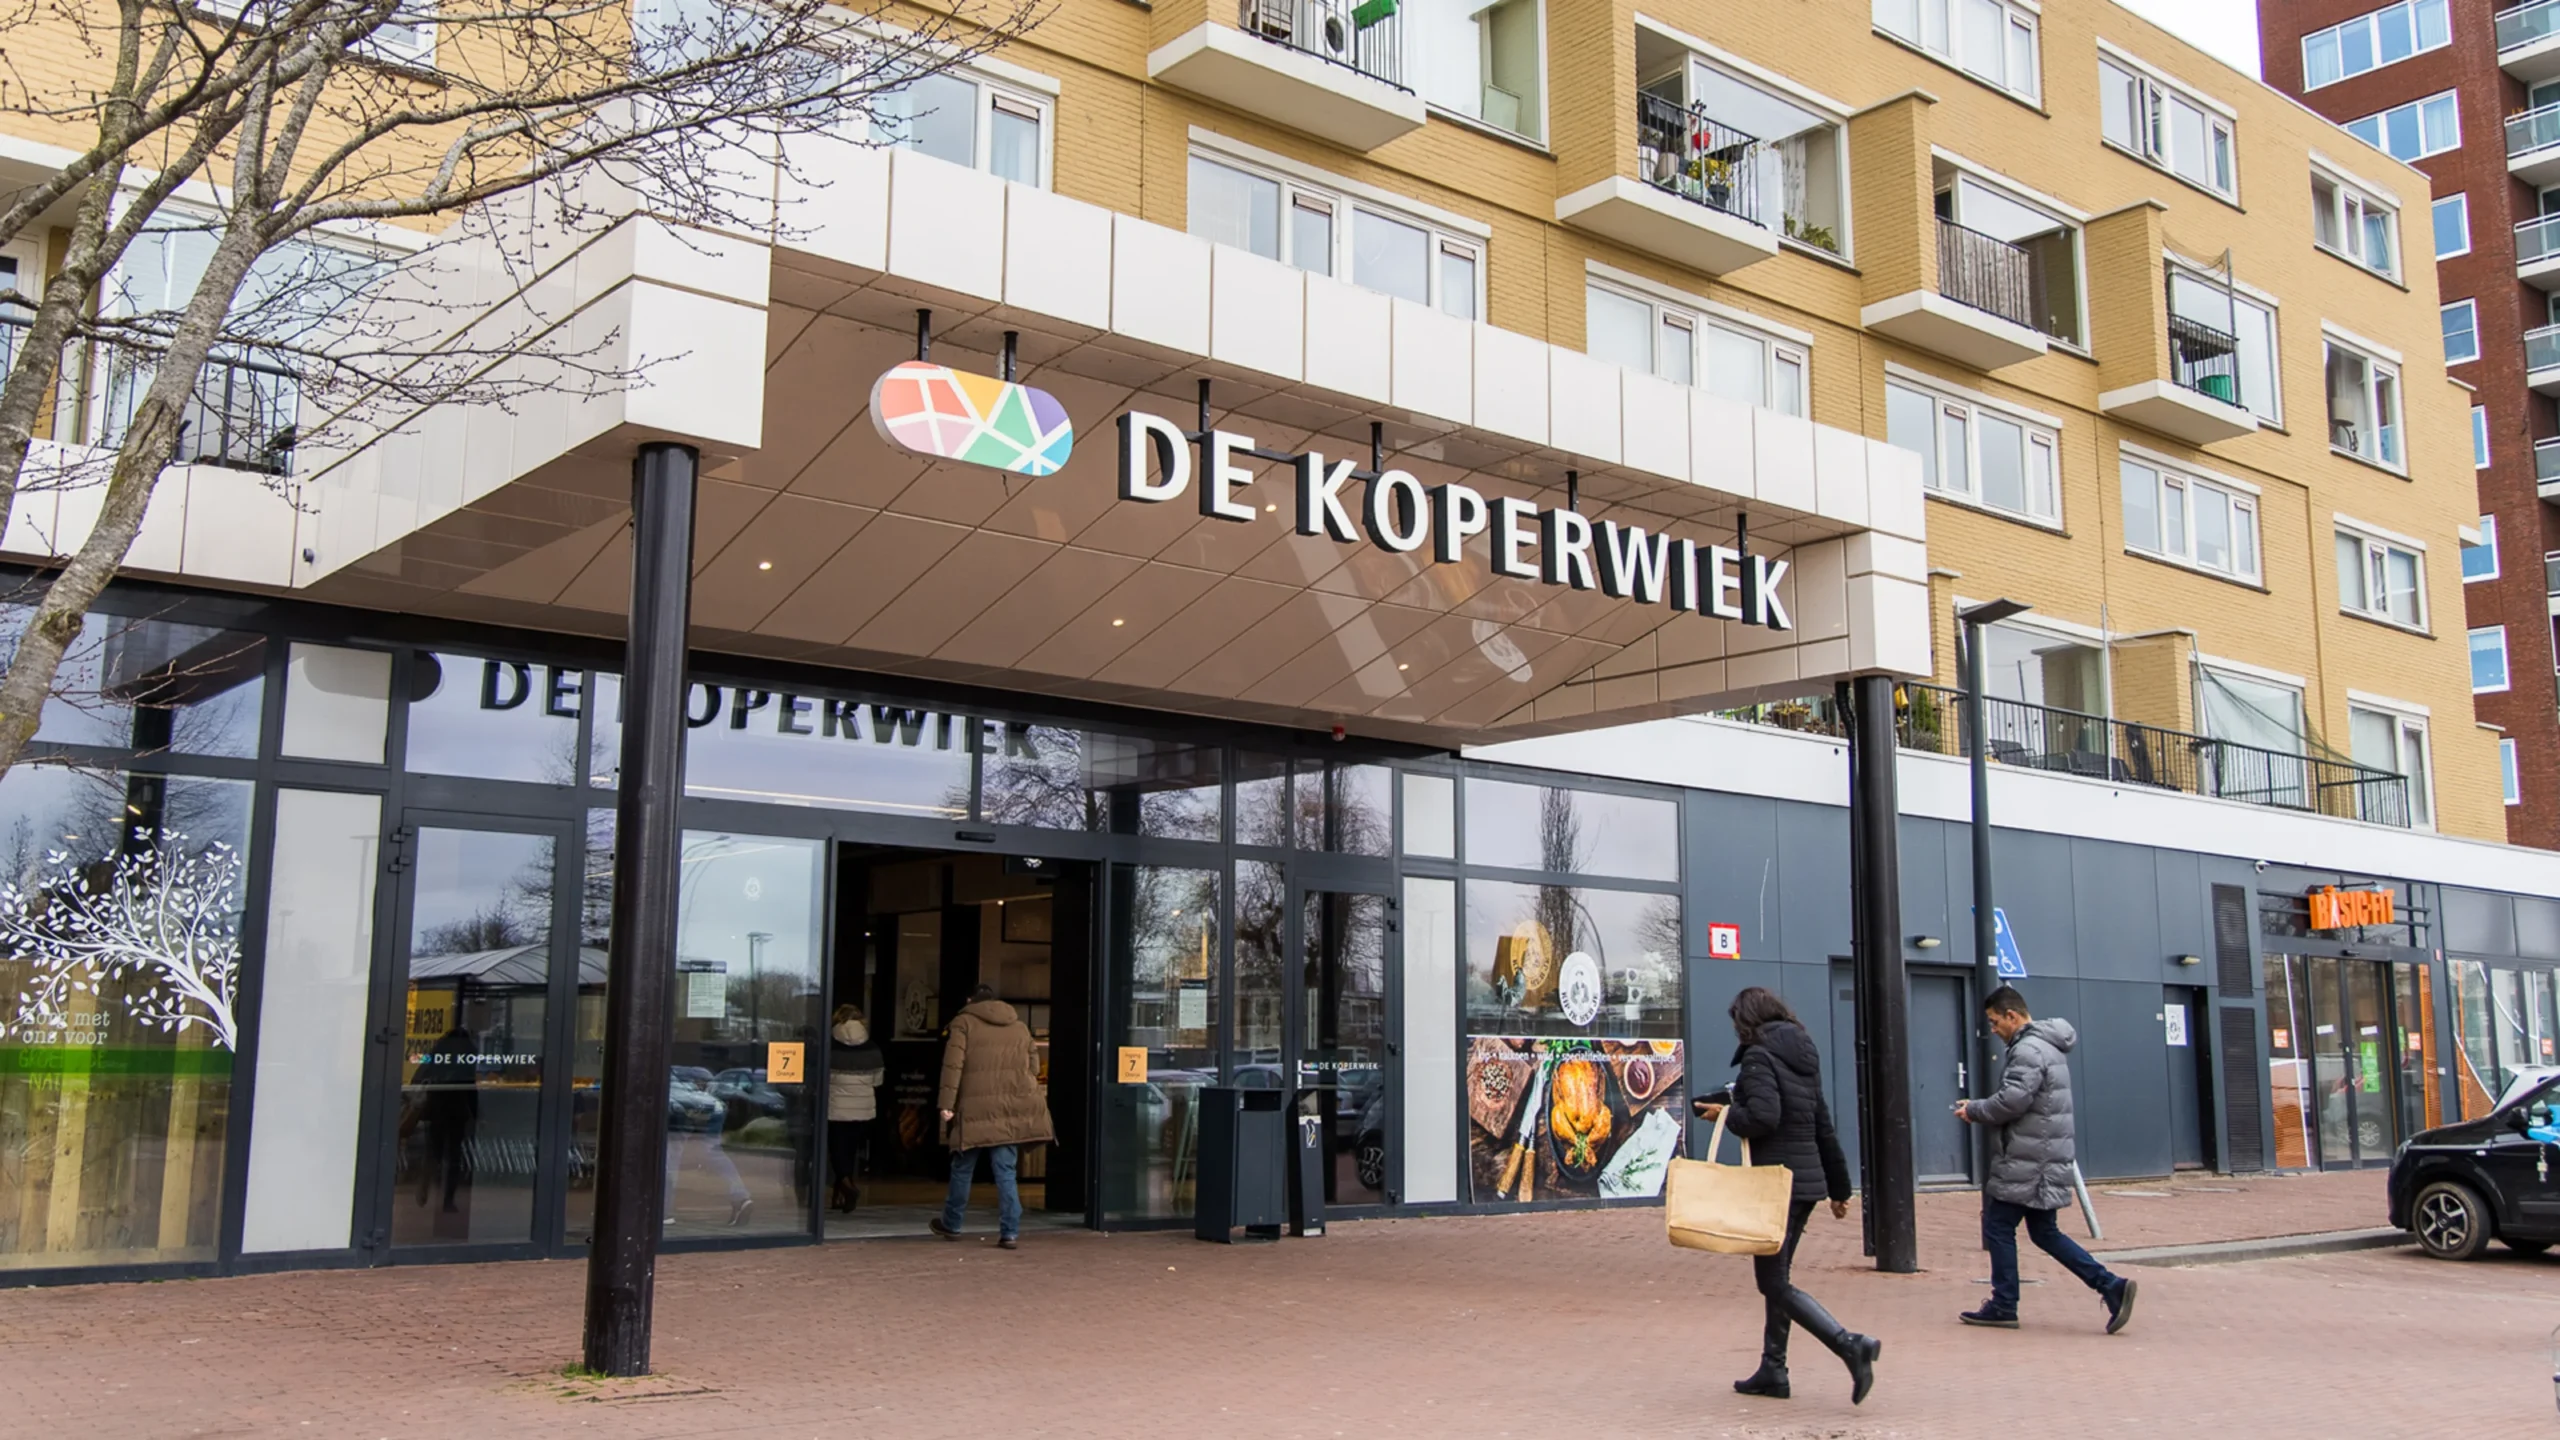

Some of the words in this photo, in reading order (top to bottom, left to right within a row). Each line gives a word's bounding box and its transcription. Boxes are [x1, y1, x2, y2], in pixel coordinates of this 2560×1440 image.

[1119, 410, 1256, 522] DE
[1296, 452, 1792, 630] KOPERWIEK
[481, 659, 581, 719] DE
[616, 675, 1039, 760] OPERWIEK
[2310, 886, 2395, 929] BASIC-FIT
[1721, 933, 1728, 948] B
[73, 1010, 110, 1026] met
[22, 1030, 58, 1045] ons
[64, 1030, 107, 1045] voor
[434, 1054, 451, 1064] DE
[457, 1053, 536, 1064] KOPERWIEK
[782, 1057, 790, 1069] 7
[1536, 1049, 1554, 1061] wild
[1561, 1050, 1610, 1062] specialiteiten
[1129, 1060, 1136, 1071] 7
[1320, 1062, 1329, 1070] DE
[1332, 1062, 1378, 1070] KOPERWIEK
